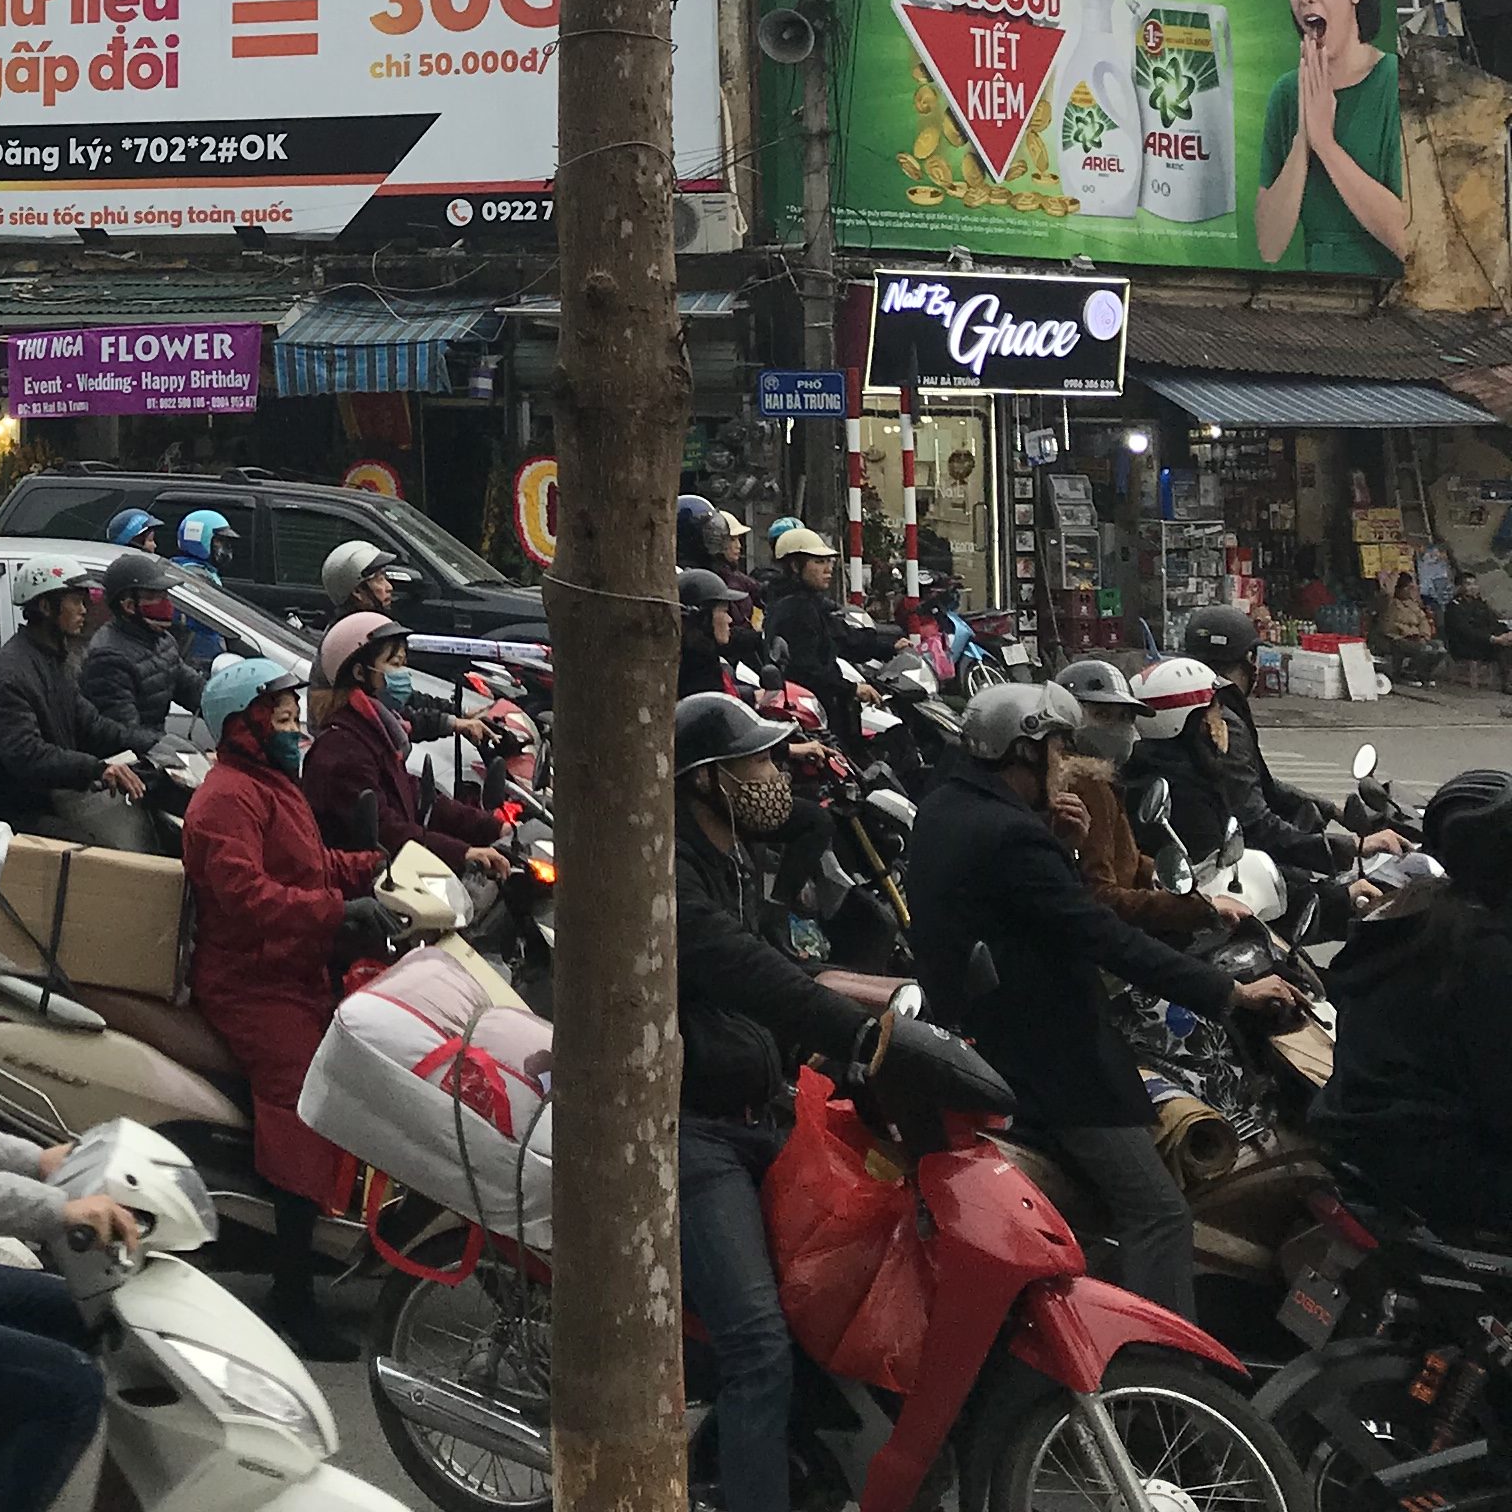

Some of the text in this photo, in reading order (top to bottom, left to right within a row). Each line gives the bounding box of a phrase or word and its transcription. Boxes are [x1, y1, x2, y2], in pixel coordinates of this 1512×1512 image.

[87, 28, 181, 93] đôi
[969, 22, 1021, 71] TIẾT
[369, 51, 413, 80] chỉ
[967, 72, 1026, 128] KIỆM
[69, 137, 114, 172] ký:
[1143, 131, 1210, 161] ARIEL
[1081, 155, 1125, 173] ARIEL
[9, 204, 49, 226] siêu
[53, 201, 86, 226] tốc
[90, 201, 126, 230] phủ
[130, 203, 183, 230] sóng
[188, 201, 237, 226] toàn
[240, 200, 294, 229] quốc
[481, 200, 540, 223] 0922
[882, 277, 958, 329] Nail By
[16, 332, 235, 363] THU NGA FLOWER
[946, 293, 1082, 376] Grace
[24, 376, 62, 395] Event
[141, 370, 186, 393] Happy
[191, 369, 251, 390] Birthday
[796, 377, 823, 390] PHỐ
[923, 376, 938, 386] HAI
[940, 373, 951, 387] BÀ
[952, 376, 981, 387] TRƯNG
[764, 389, 842, 411] HAI BÀ TRƯNG
